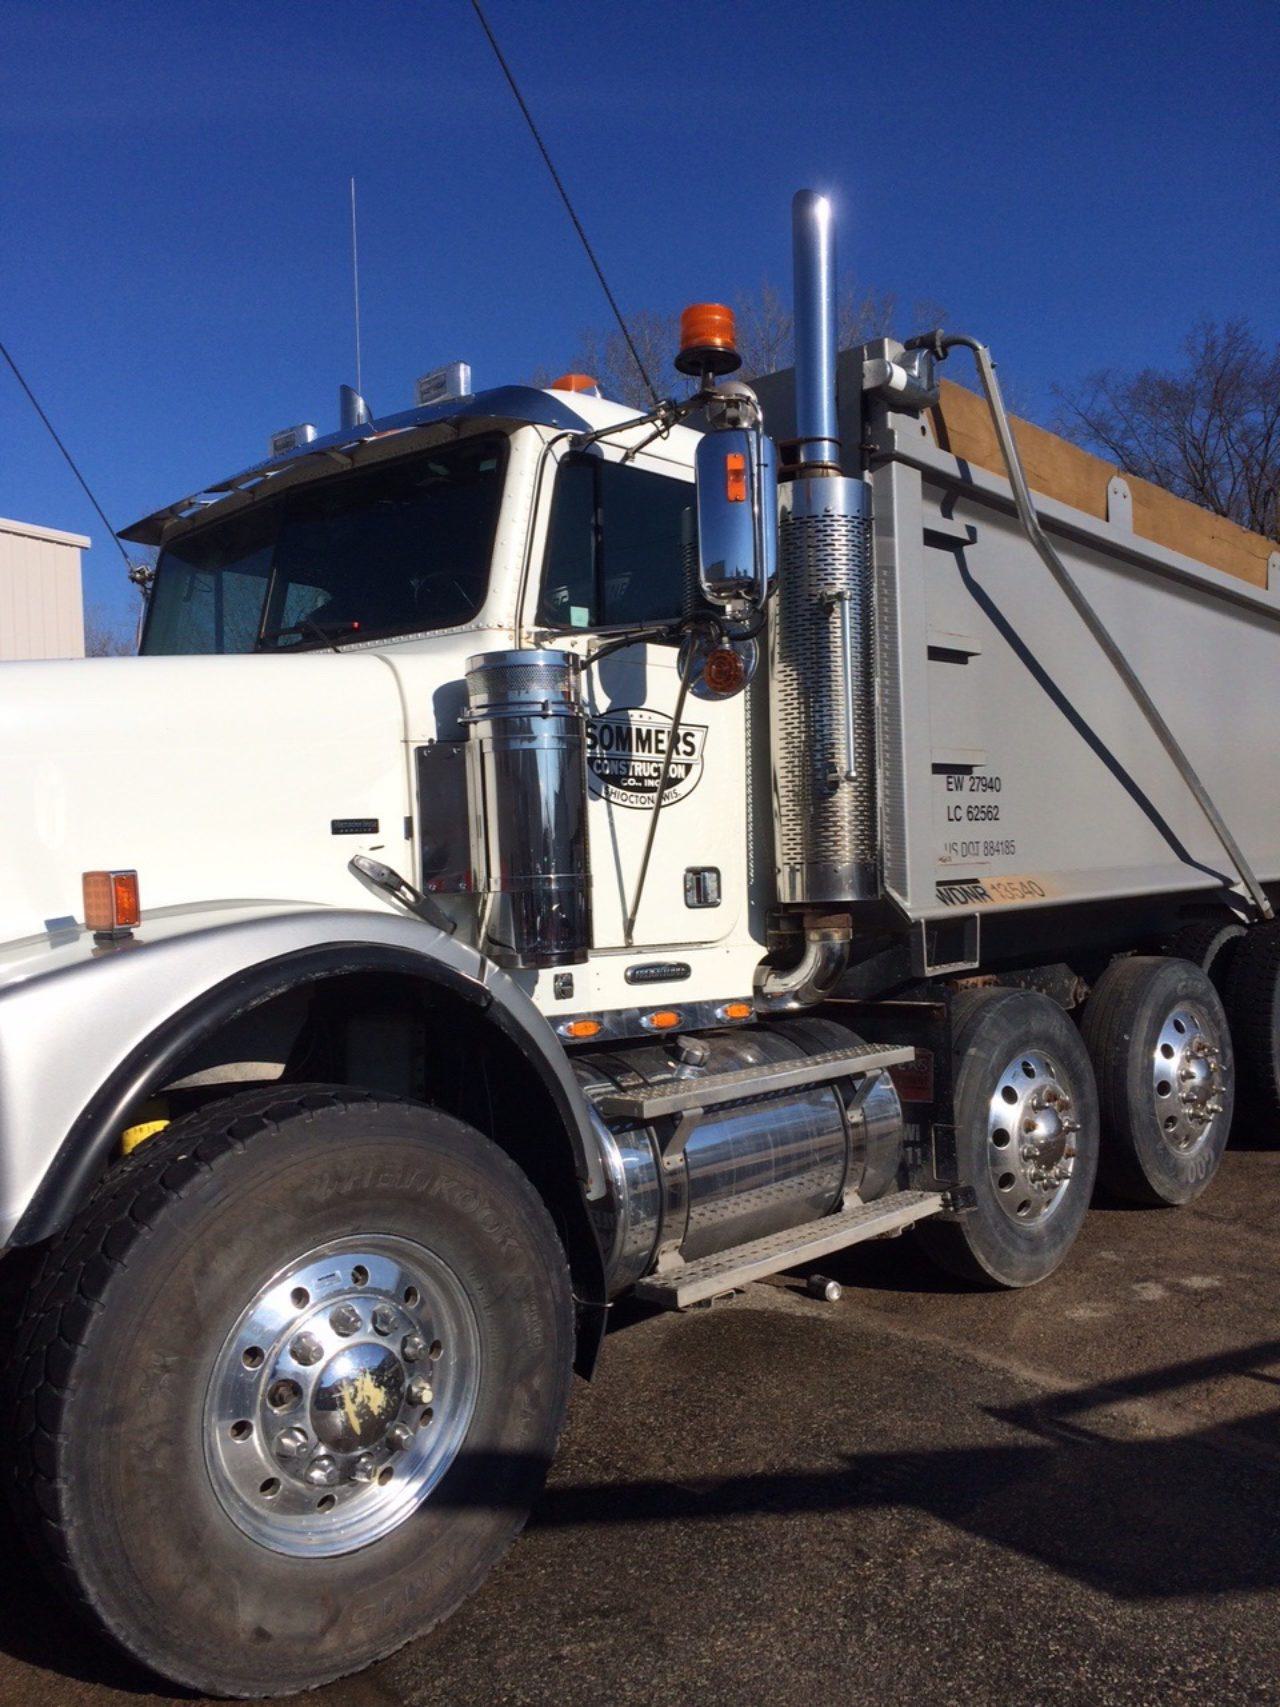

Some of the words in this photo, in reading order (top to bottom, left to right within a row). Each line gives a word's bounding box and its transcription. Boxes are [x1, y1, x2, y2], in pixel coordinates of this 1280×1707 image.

[586, 723, 696, 757] SOMMERS
[593, 760, 686, 778] CONSTRUCTON
[946, 775, 965, 792] EW
[969, 776, 1001, 792] 27940
[947, 805, 963, 822] LC
[966, 805, 1000, 822] 62562
